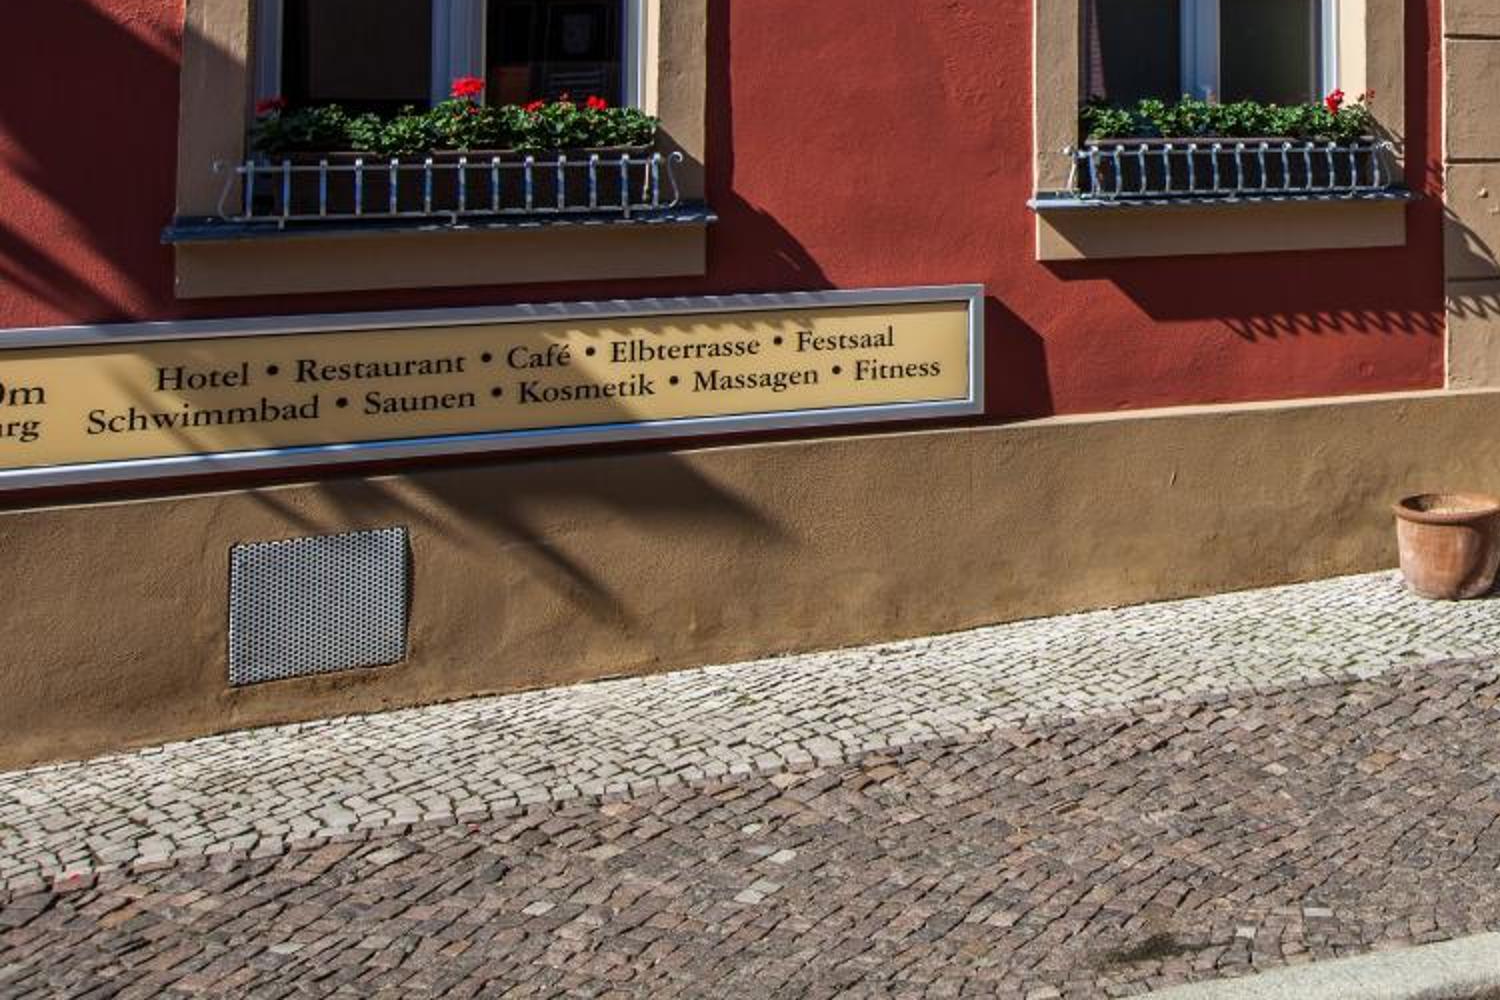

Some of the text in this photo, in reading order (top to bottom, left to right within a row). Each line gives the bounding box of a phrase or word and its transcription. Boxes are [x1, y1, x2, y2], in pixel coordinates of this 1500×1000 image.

[156, 326, 895, 392] Hotel Restaurant Café Elbterrasse Festsaal
[86, 357, 942, 436] Schwimmbad Saunen Kosmetik Massagen Fitness
